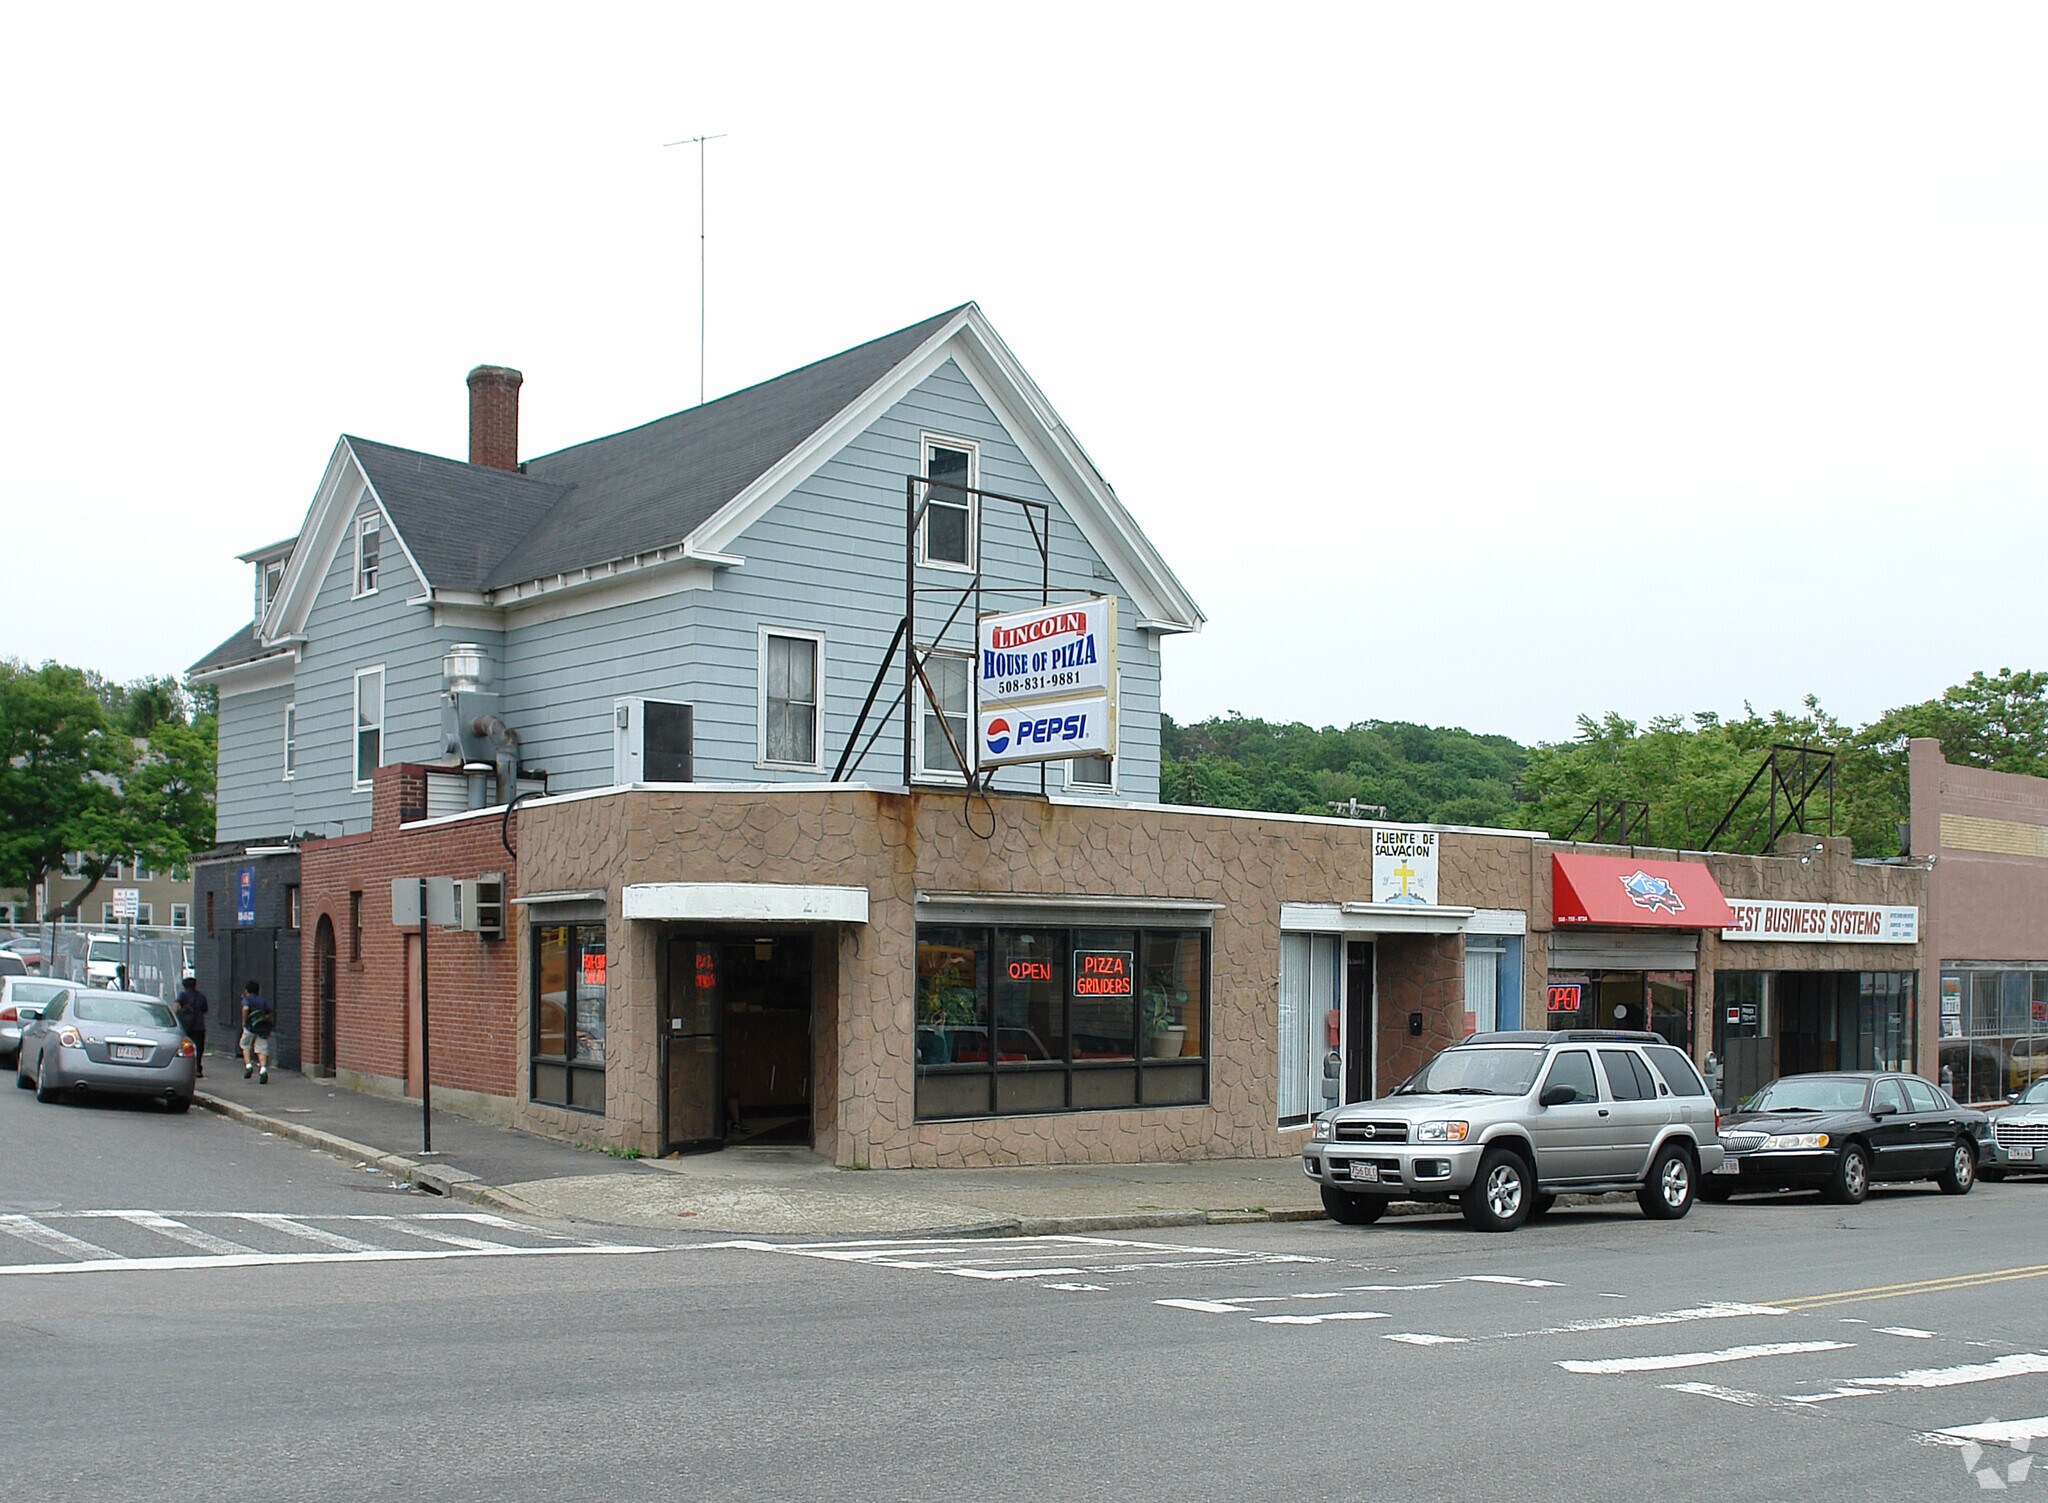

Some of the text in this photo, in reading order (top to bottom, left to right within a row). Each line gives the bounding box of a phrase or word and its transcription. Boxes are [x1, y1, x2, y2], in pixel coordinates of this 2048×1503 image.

[1000, 613, 1079, 648] LINCOLN
[983, 634, 1097, 679] HOUSE OF PIZZA
[999, 671, 1080, 693] 508-831-9881
[1016, 714, 1087, 745] PEPSI
[1377, 832, 1435, 844] FUENTE DE
[1375, 845, 1430, 857] SALVACION
[1764, 907, 1827, 934] BUSINESS
[1830, 910, 1882, 935] SYSTEMS
[1009, 962, 1051, 980] OPEN
[1085, 957, 1123, 974] PIZZA
[1077, 977, 1130, 994] GRINDERS
[1547, 986, 1579, 1010] OPEN
